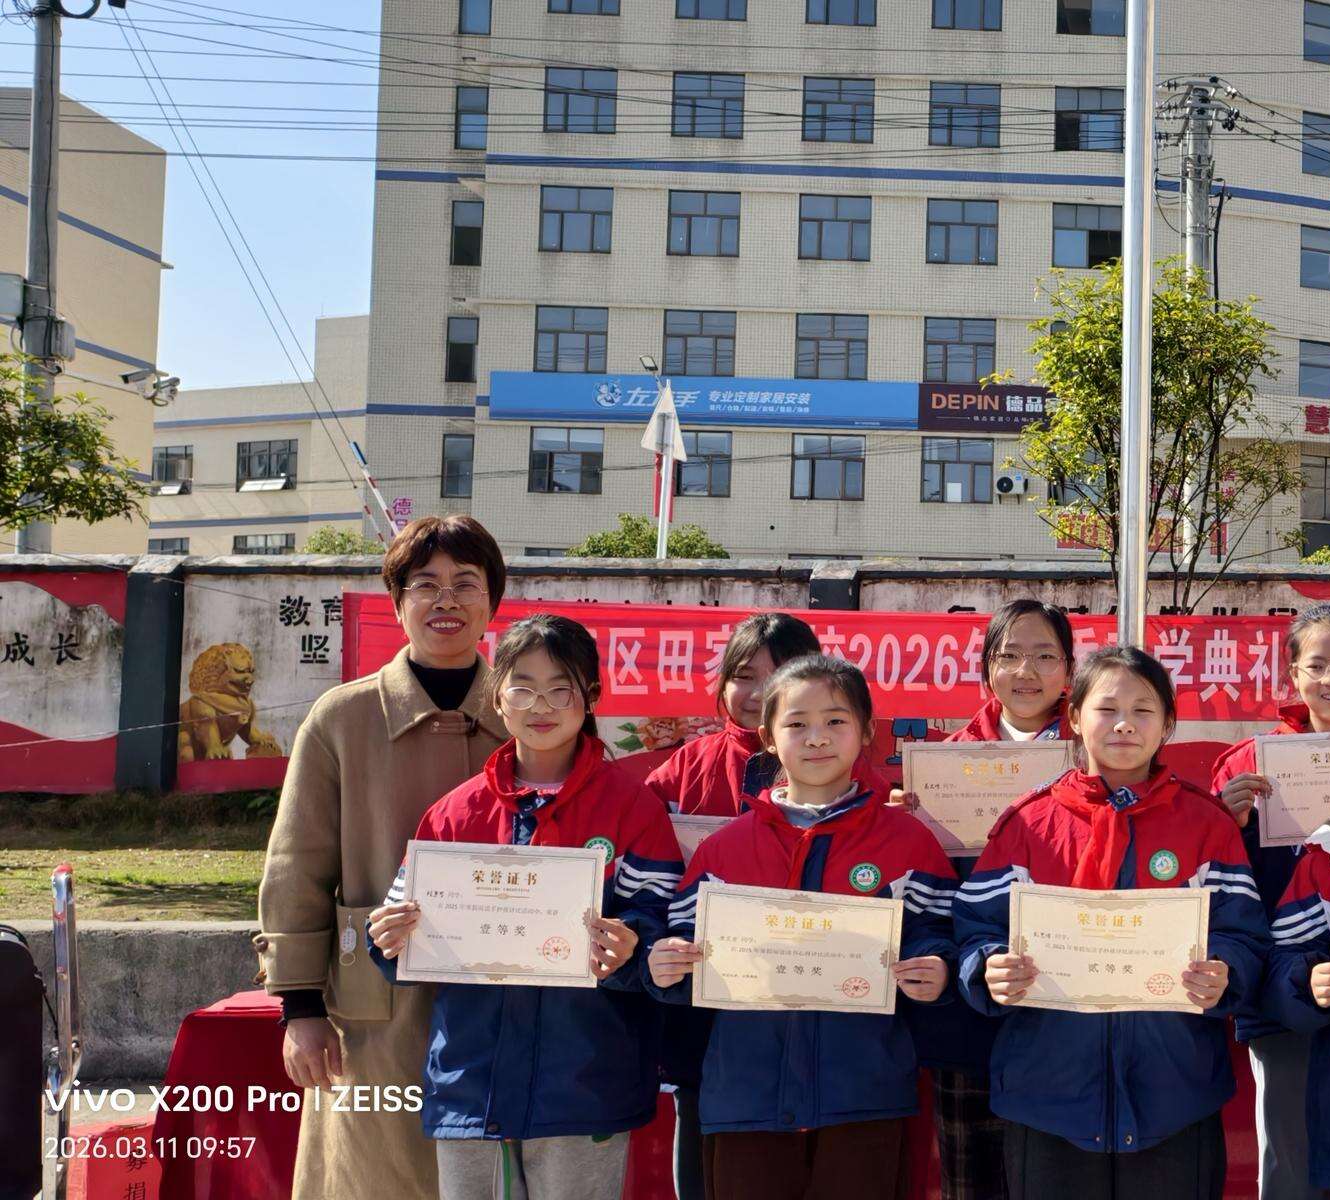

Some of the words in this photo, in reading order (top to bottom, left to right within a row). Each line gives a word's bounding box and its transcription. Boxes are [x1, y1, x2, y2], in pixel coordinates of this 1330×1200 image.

[623, 389, 701, 408] 左手
[708, 390, 811, 406] 专业定制家居安装
[931, 392, 999, 411] DEPIN
[1, 632, 82, 666] 成长
[300, 634, 330, 664] 坚
[471, 869, 539, 886] 荣誉证书
[480, 923, 528, 937] 壹等奖
[764, 914, 833, 930] 荣誉证书
[775, 964, 823, 977] 壹等奖
[1088, 962, 1134, 975] 贰等奖
